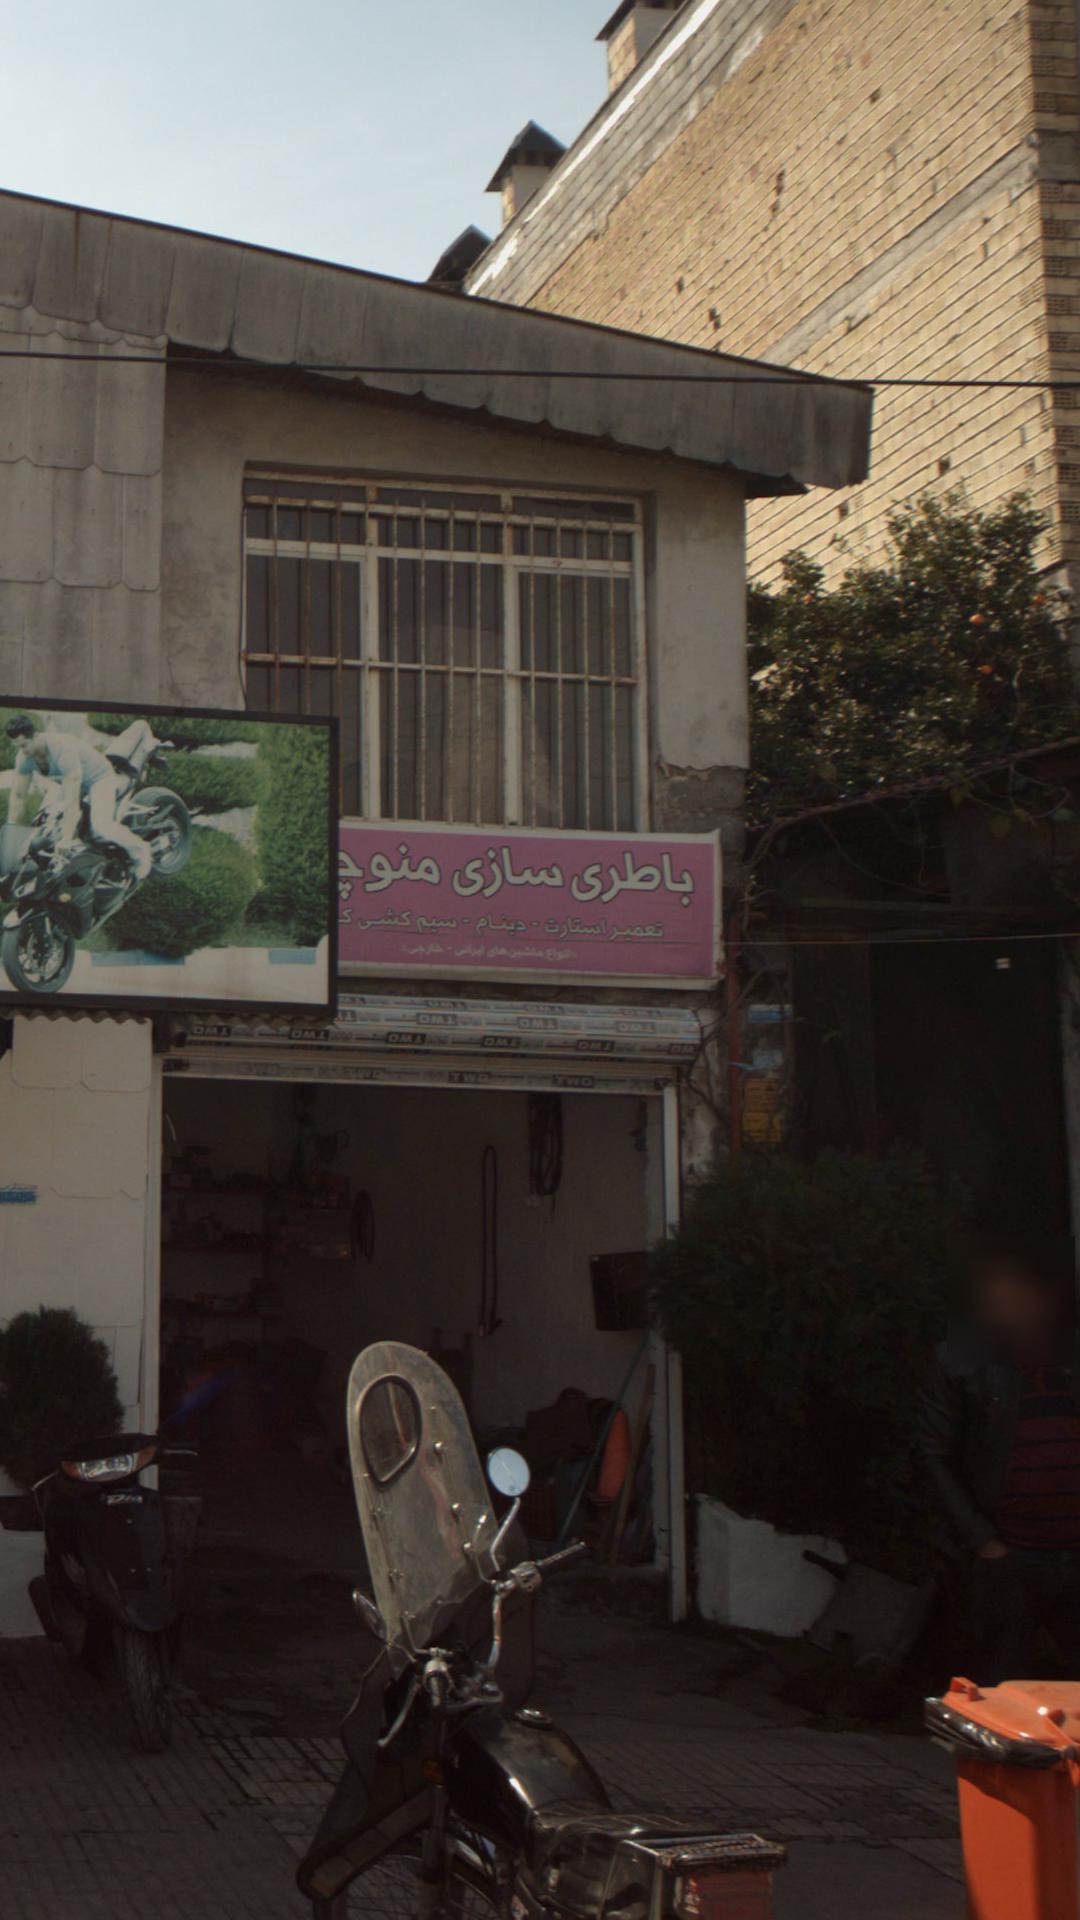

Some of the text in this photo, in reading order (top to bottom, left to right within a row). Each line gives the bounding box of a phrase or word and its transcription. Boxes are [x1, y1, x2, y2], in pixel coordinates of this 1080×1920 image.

[338, 842, 695, 908] باطری سازی منوچ
[358, 908, 411, 930] کشی
[416, 916, 457, 933] سیم
[475, 914, 528, 937] دینام
[543, 917, 607, 938] استارت
[609, 921, 664, 942] تعمیر
